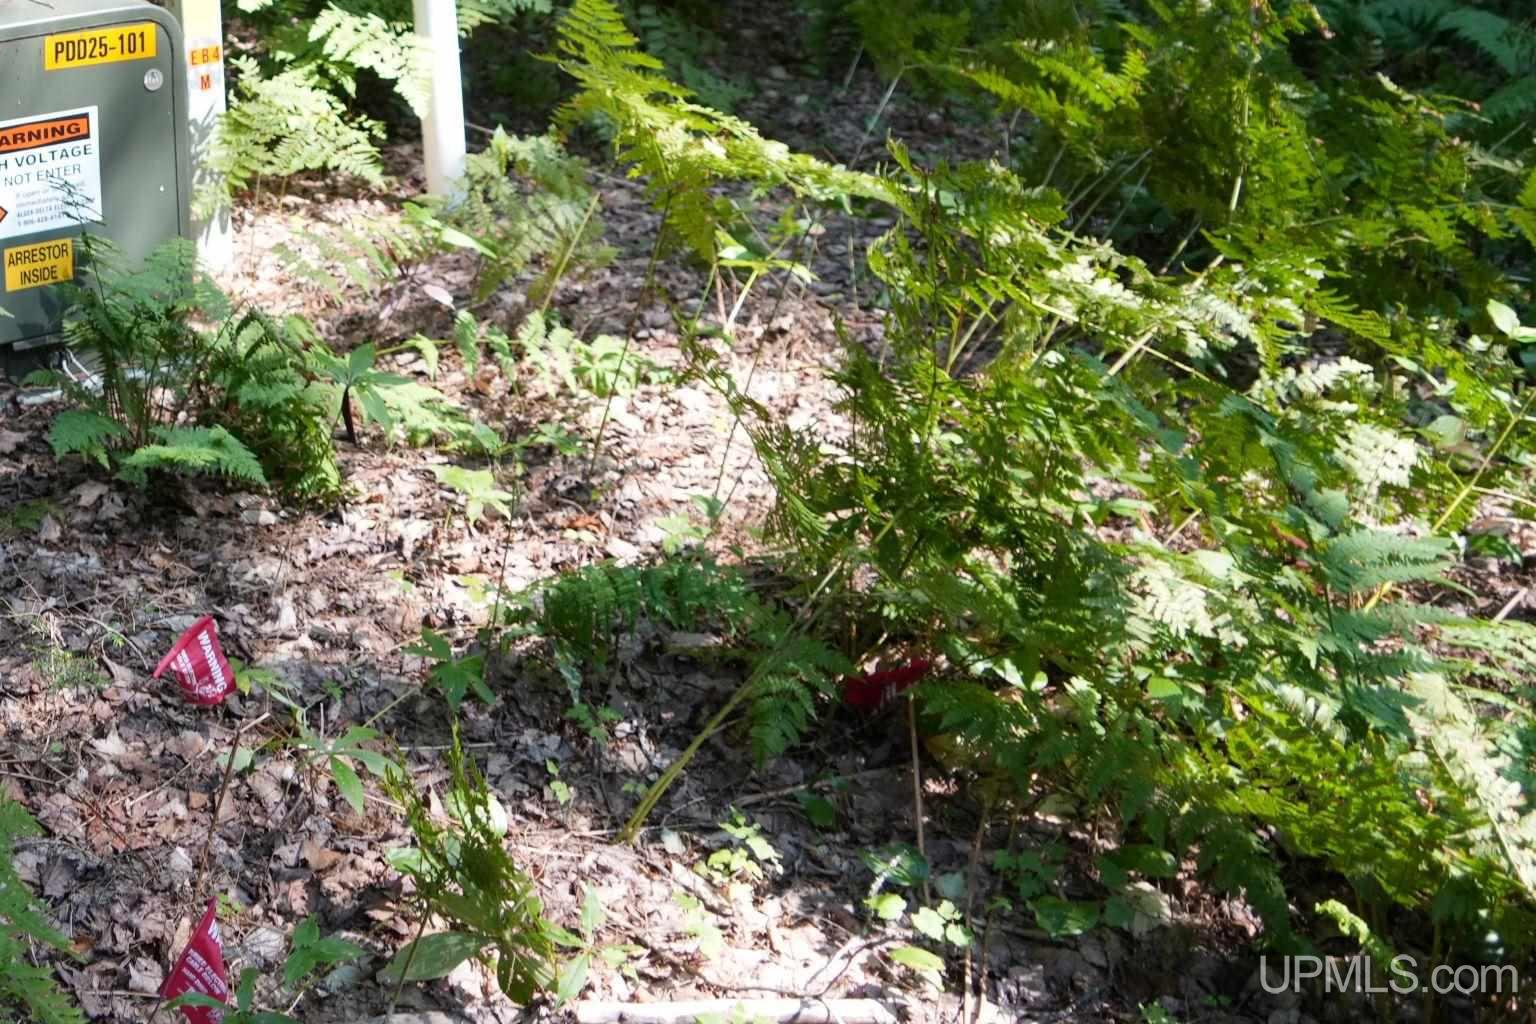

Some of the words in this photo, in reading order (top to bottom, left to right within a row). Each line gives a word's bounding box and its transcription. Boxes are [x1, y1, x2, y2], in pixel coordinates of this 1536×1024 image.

[54, 31, 146, 64] PDD25-101
[14, 143, 93, 168] VOLTAGE
[4, 172, 32, 187] NOT
[36, 163, 81, 182] ENTER
[7, 242, 69, 267] ARRESTOR
[20, 265, 59, 286] INSIDE
[197, 629, 228, 694] WARNING
